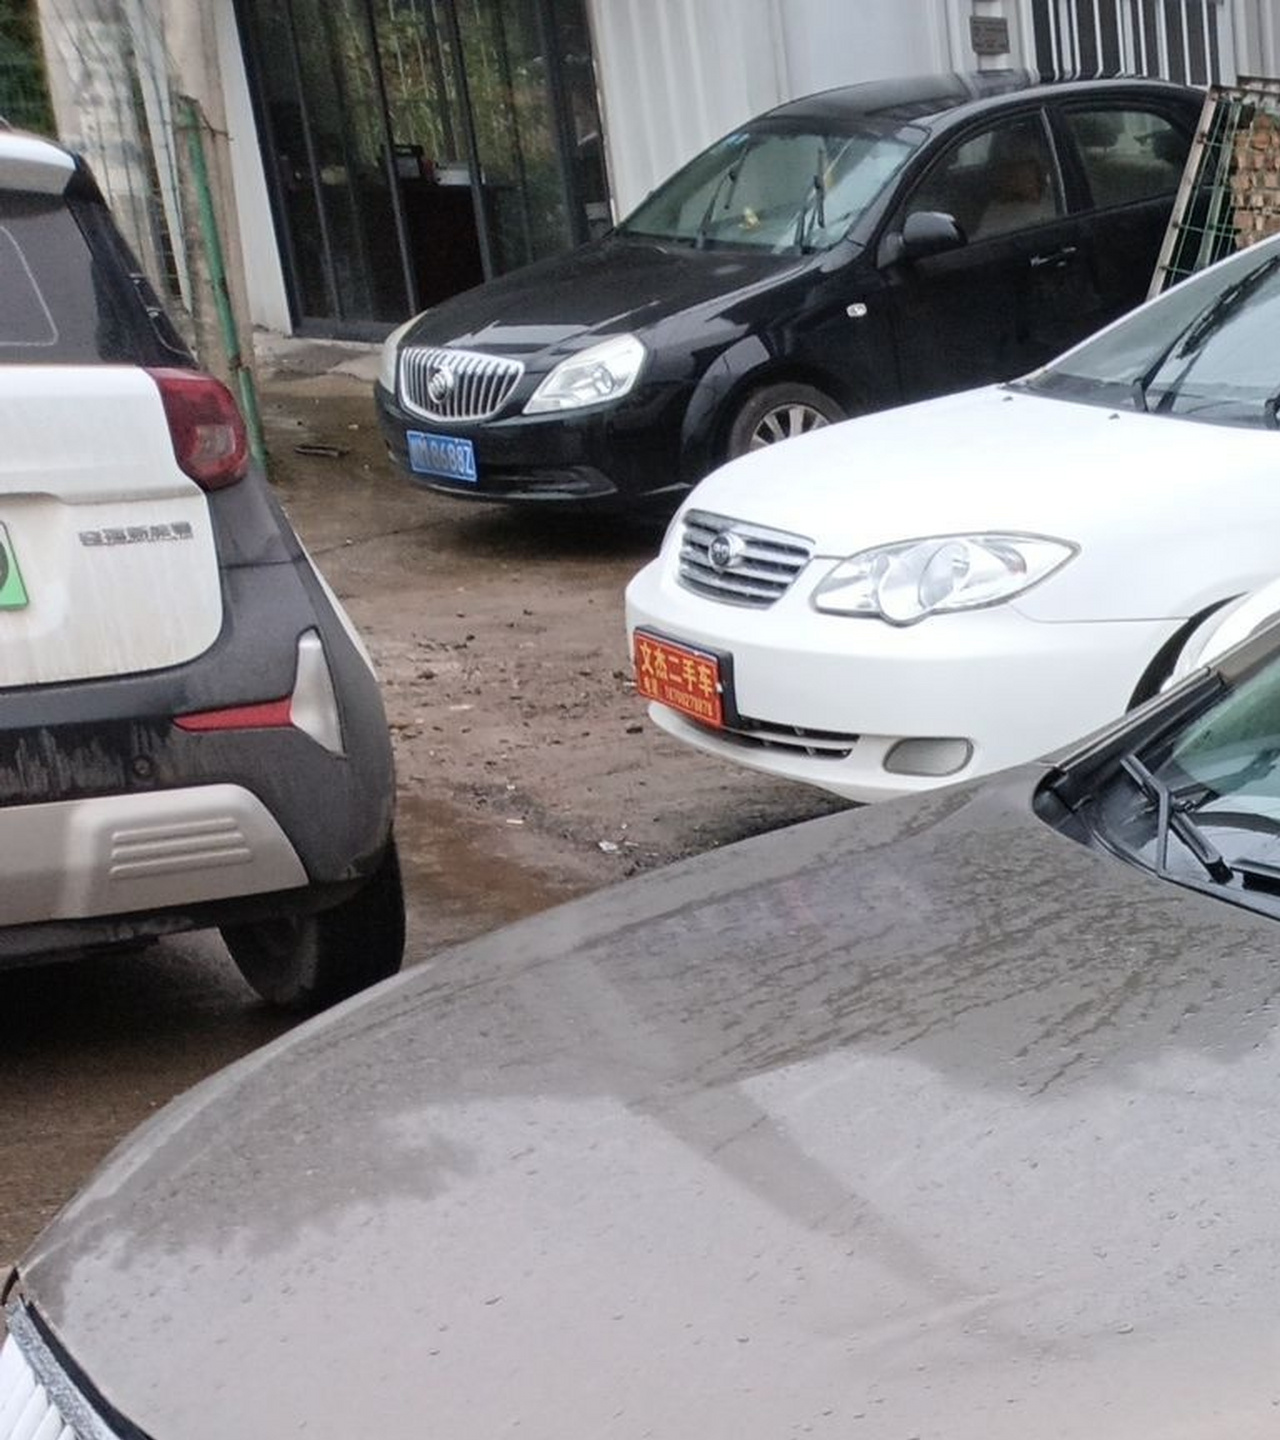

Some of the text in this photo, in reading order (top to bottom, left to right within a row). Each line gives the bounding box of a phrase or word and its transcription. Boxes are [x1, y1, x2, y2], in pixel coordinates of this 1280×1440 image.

[639, 641, 713, 698] 文杰二手车
